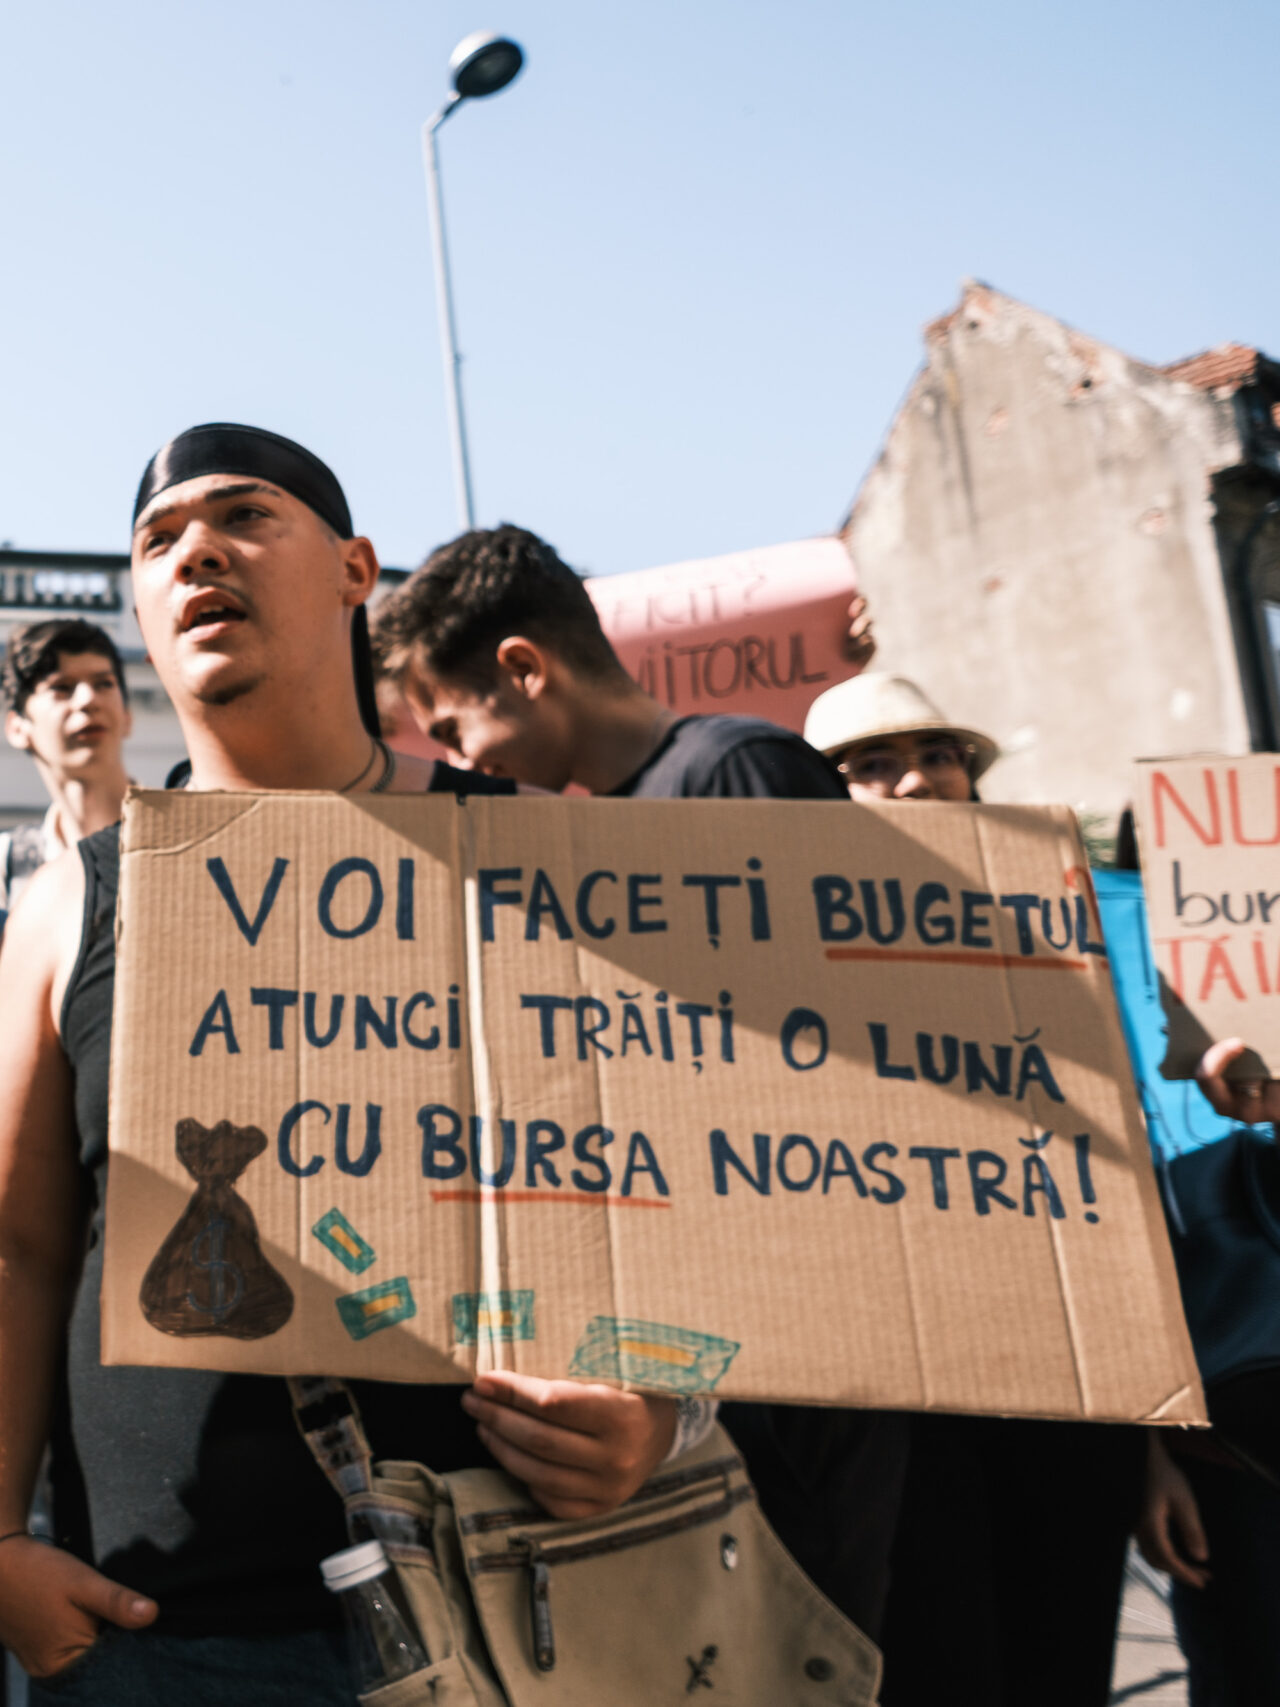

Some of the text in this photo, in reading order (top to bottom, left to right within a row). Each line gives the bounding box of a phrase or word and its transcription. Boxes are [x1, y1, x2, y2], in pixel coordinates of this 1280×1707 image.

[206, 856, 416, 946] VOI
[811, 874, 1107, 957] BUGETUL
[780, 1007, 830, 1072] O
[867, 1022, 1066, 1103] LUNĂ
[277, 1100, 1100, 1225] CU BURSA NOASTRĂ!
